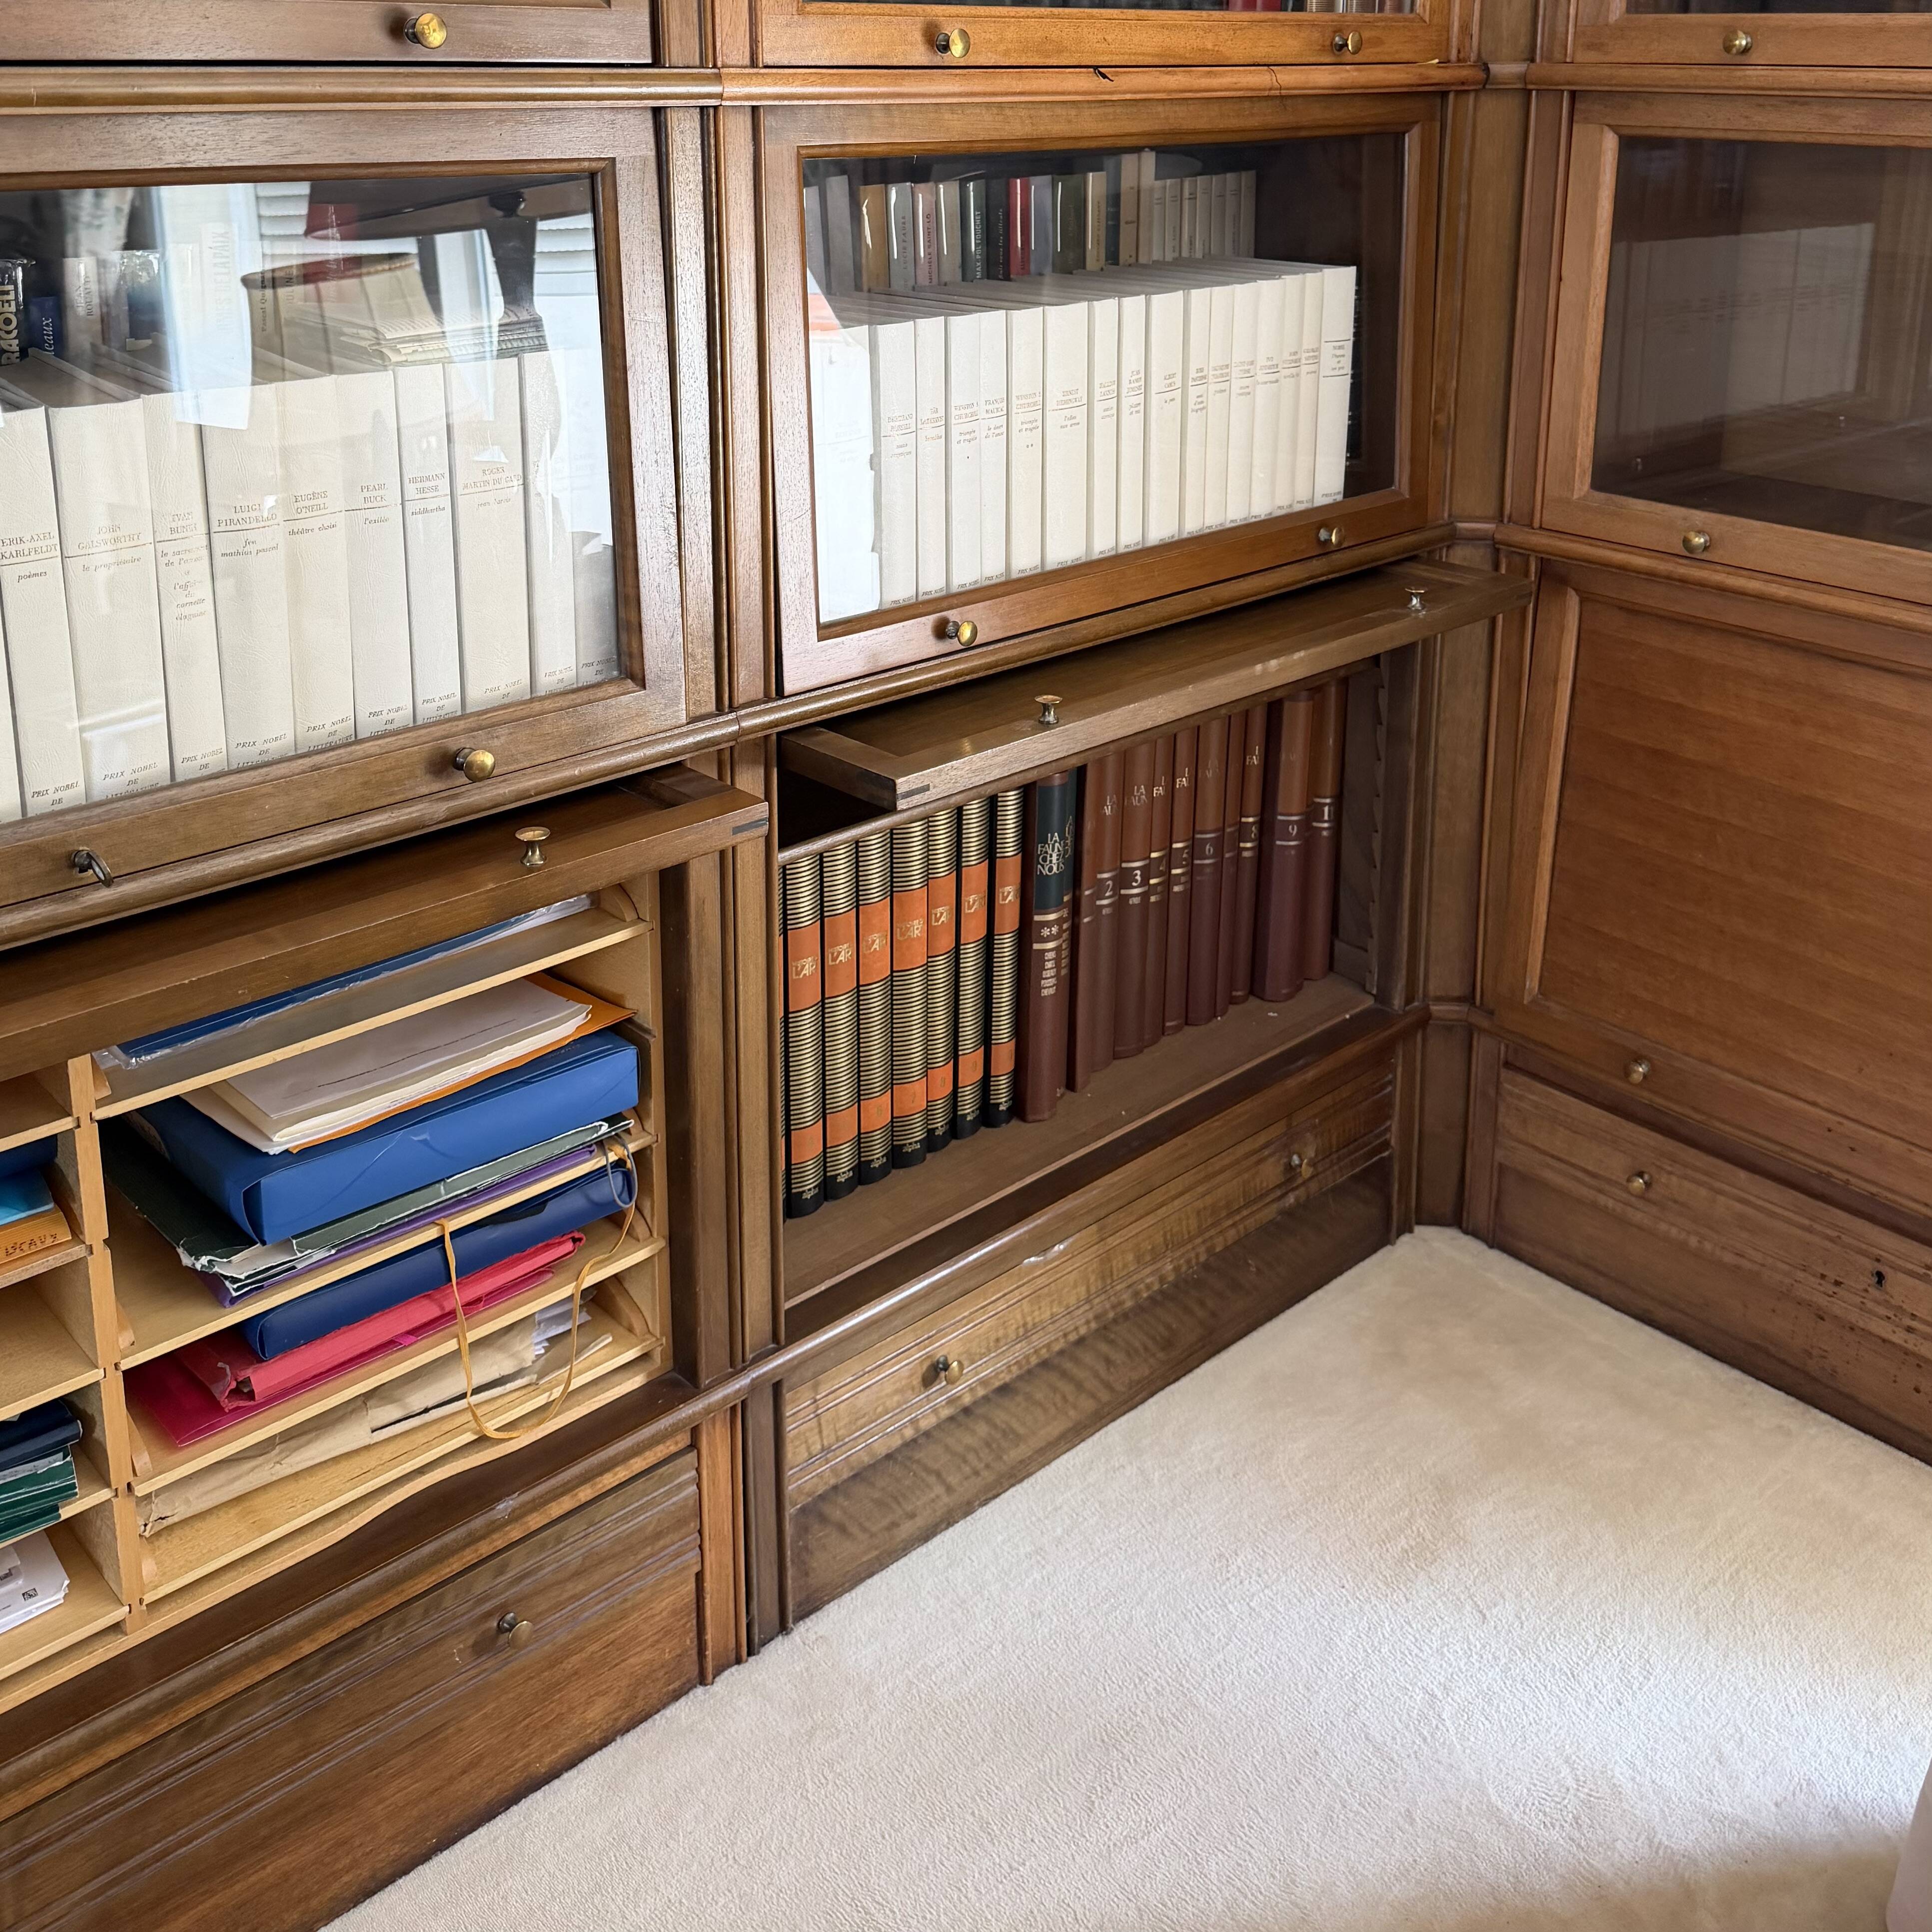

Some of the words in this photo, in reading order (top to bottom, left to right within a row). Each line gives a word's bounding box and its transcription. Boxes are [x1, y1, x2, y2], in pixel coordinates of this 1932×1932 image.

[212, 231, 230, 259] PAIX
[408, 473, 446, 484] HERMANN
[462, 479, 490, 491] MARTIN
[492, 477, 503, 486] DU
[360, 483, 388, 493] PEARL
[416, 485, 439, 495] HESSE
[363, 495, 387, 504] BUCK
[233, 503, 261, 514] LUIGI
[296, 503, 329, 515] O'NEILL
[410, 505, 446, 516] siddhartha
[217, 513, 277, 527] PIRANDELLO
[288, 526, 314, 536] théâtre
[0, 531, 55, 548] ERIK-AXEL
[78, 532, 142, 551] GALSWORTHY
[0, 543, 58, 561] KARLFELDT
[93, 556, 141, 573] propriétaire
[165, 558, 174, 568] de
[17, 571, 47, 583] poèmes
[368, 708, 385, 718] PRIX
[306, 723, 326, 733] PRIX
[329, 715, 352, 727] NOBEL
[327, 730, 338, 738] DE
[235, 740, 257, 749] PRIX
[263, 733, 287, 745] NOBEL
[201, 747, 223, 759] NOBEL
[102, 770, 125, 781] PRIX
[130, 762, 158, 775] NOBEL
[199, 762, 209, 771] DE
[126, 778, 139, 786] DE
[31, 788, 49, 799] PRIX
[52, 781, 80, 794] NOBEL
[1134, 785, 1146, 796] LA
[50, 797, 63, 806] DE
[1251, 825, 1257, 839] 8
[1288, 824, 1297, 837] 9
[1047, 832, 1060, 844] LA
[1205, 842, 1214, 856] 6
[1039, 851, 1064, 865] CHEZ
[1037, 860, 1065, 876] NOUS
[1131, 870, 1141, 887] 3
[1104, 880, 1113, 897] 2
[940, 1076, 946, 1088] 8
